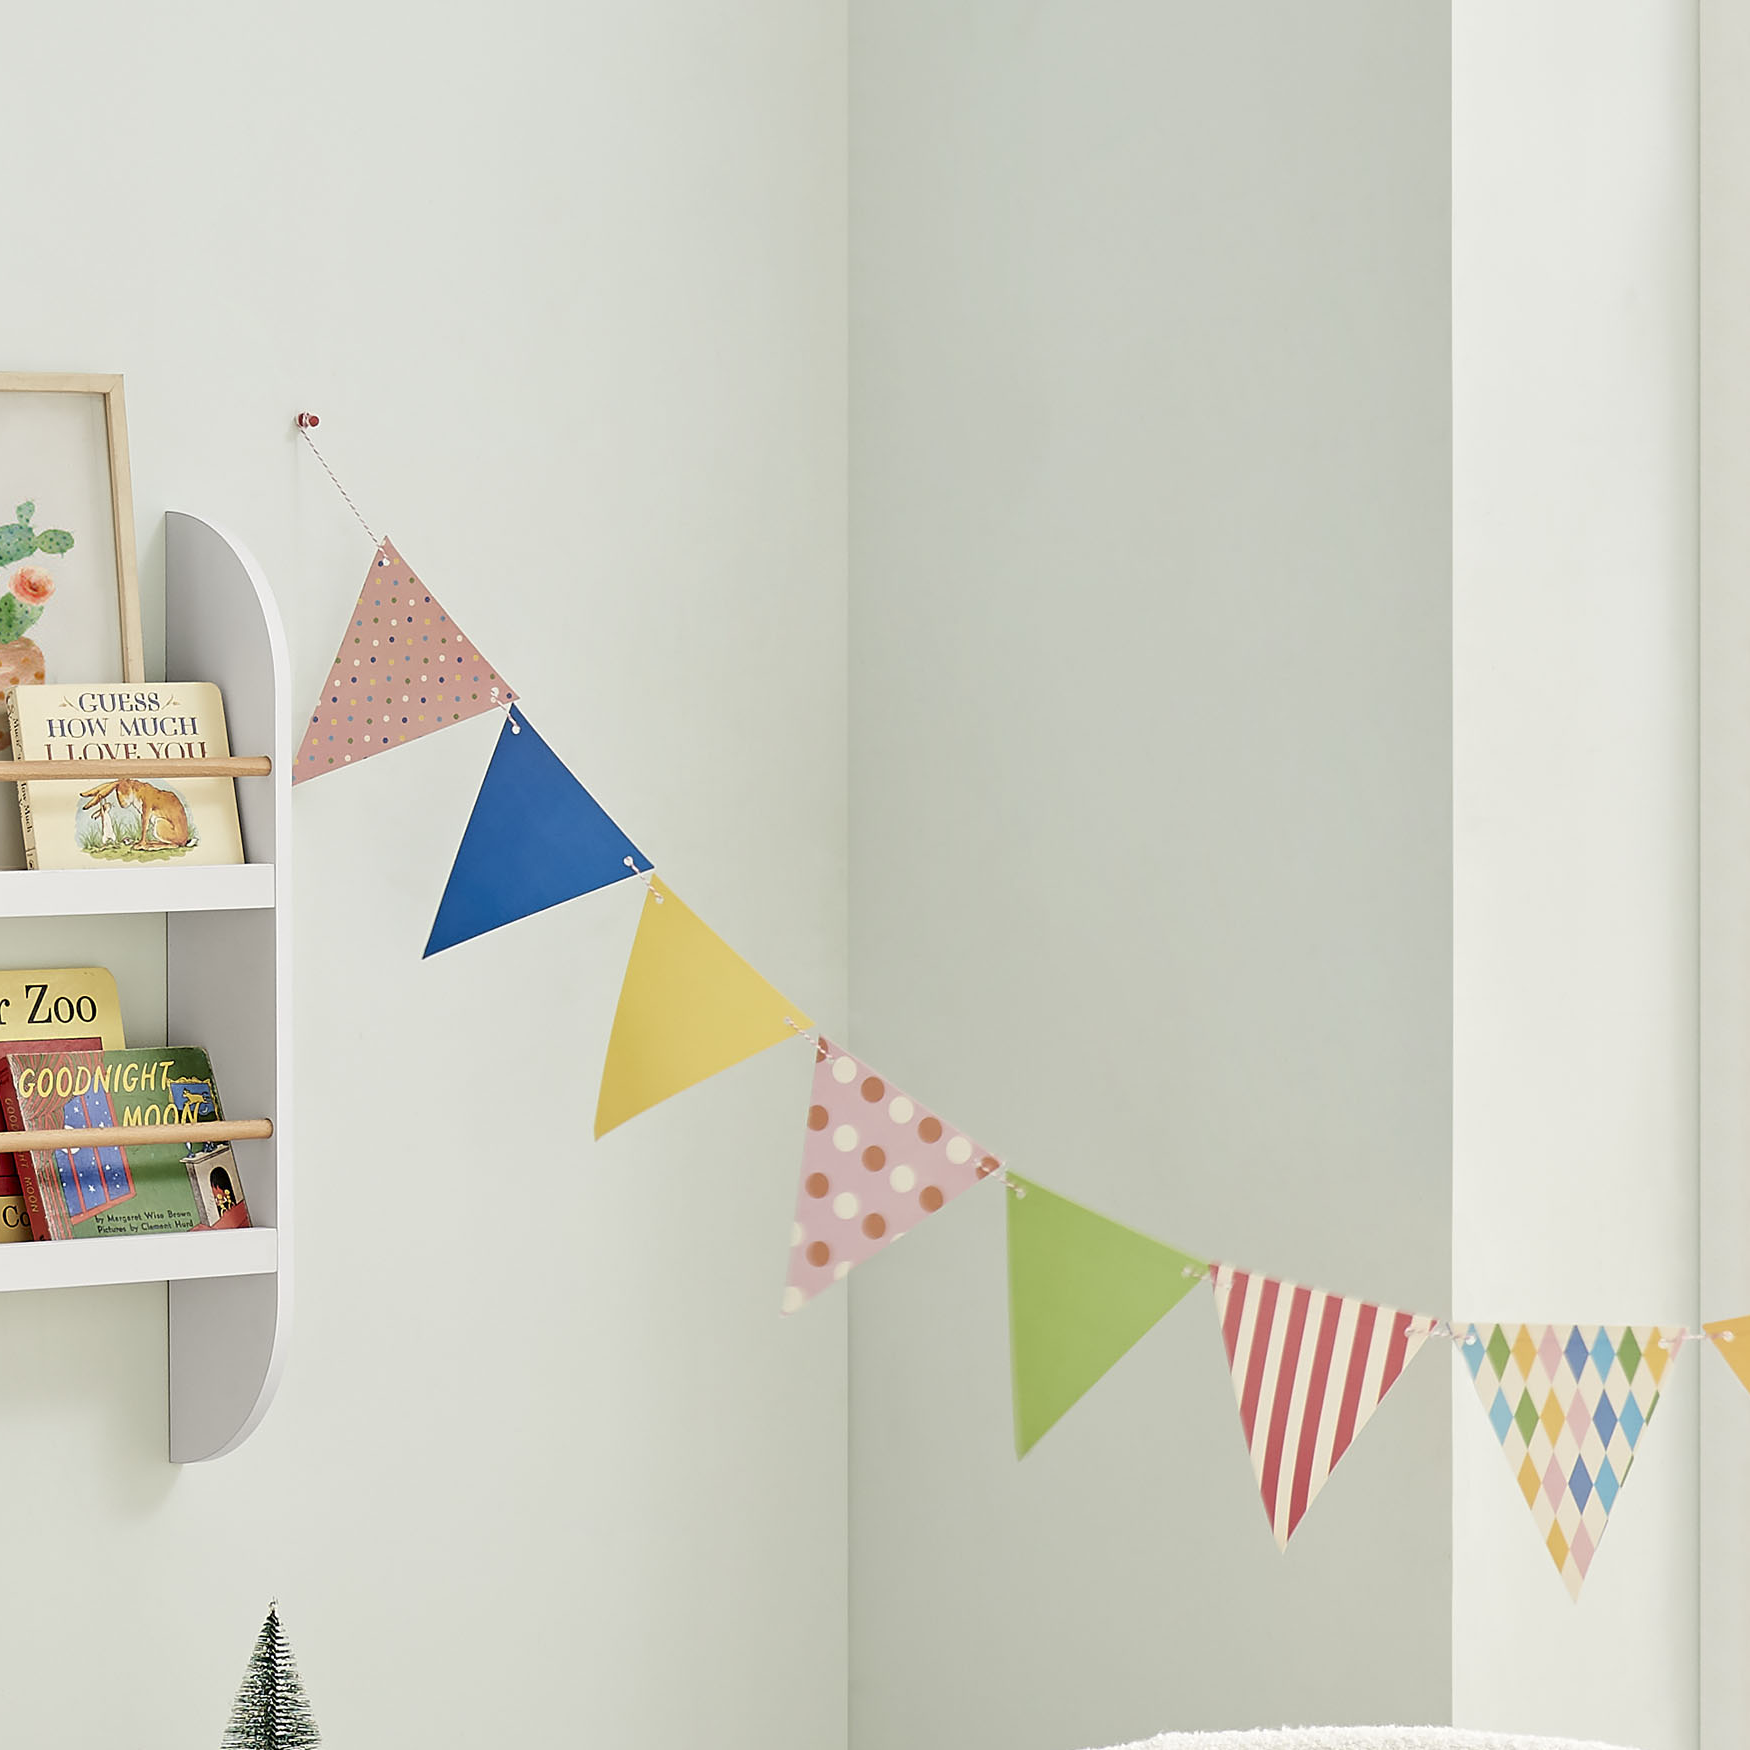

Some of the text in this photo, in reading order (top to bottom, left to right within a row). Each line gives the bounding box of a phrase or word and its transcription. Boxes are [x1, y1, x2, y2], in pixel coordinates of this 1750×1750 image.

[78, 692, 161, 713] GUESS
[46, 716, 200, 738] HOW MUCH
[44, 741, 208, 760] I LOVE YOU
[25, 984, 97, 1024] Zoo
[18, 1060, 175, 1098] GOODNIGHT
[123, 1101, 200, 1127] MOON
[24, 1176, 39, 1213] MOON
[94, 1215, 104, 1224] by
[97, 1225, 126, 1234] Pictures
[130, 1223, 139, 1232] by
